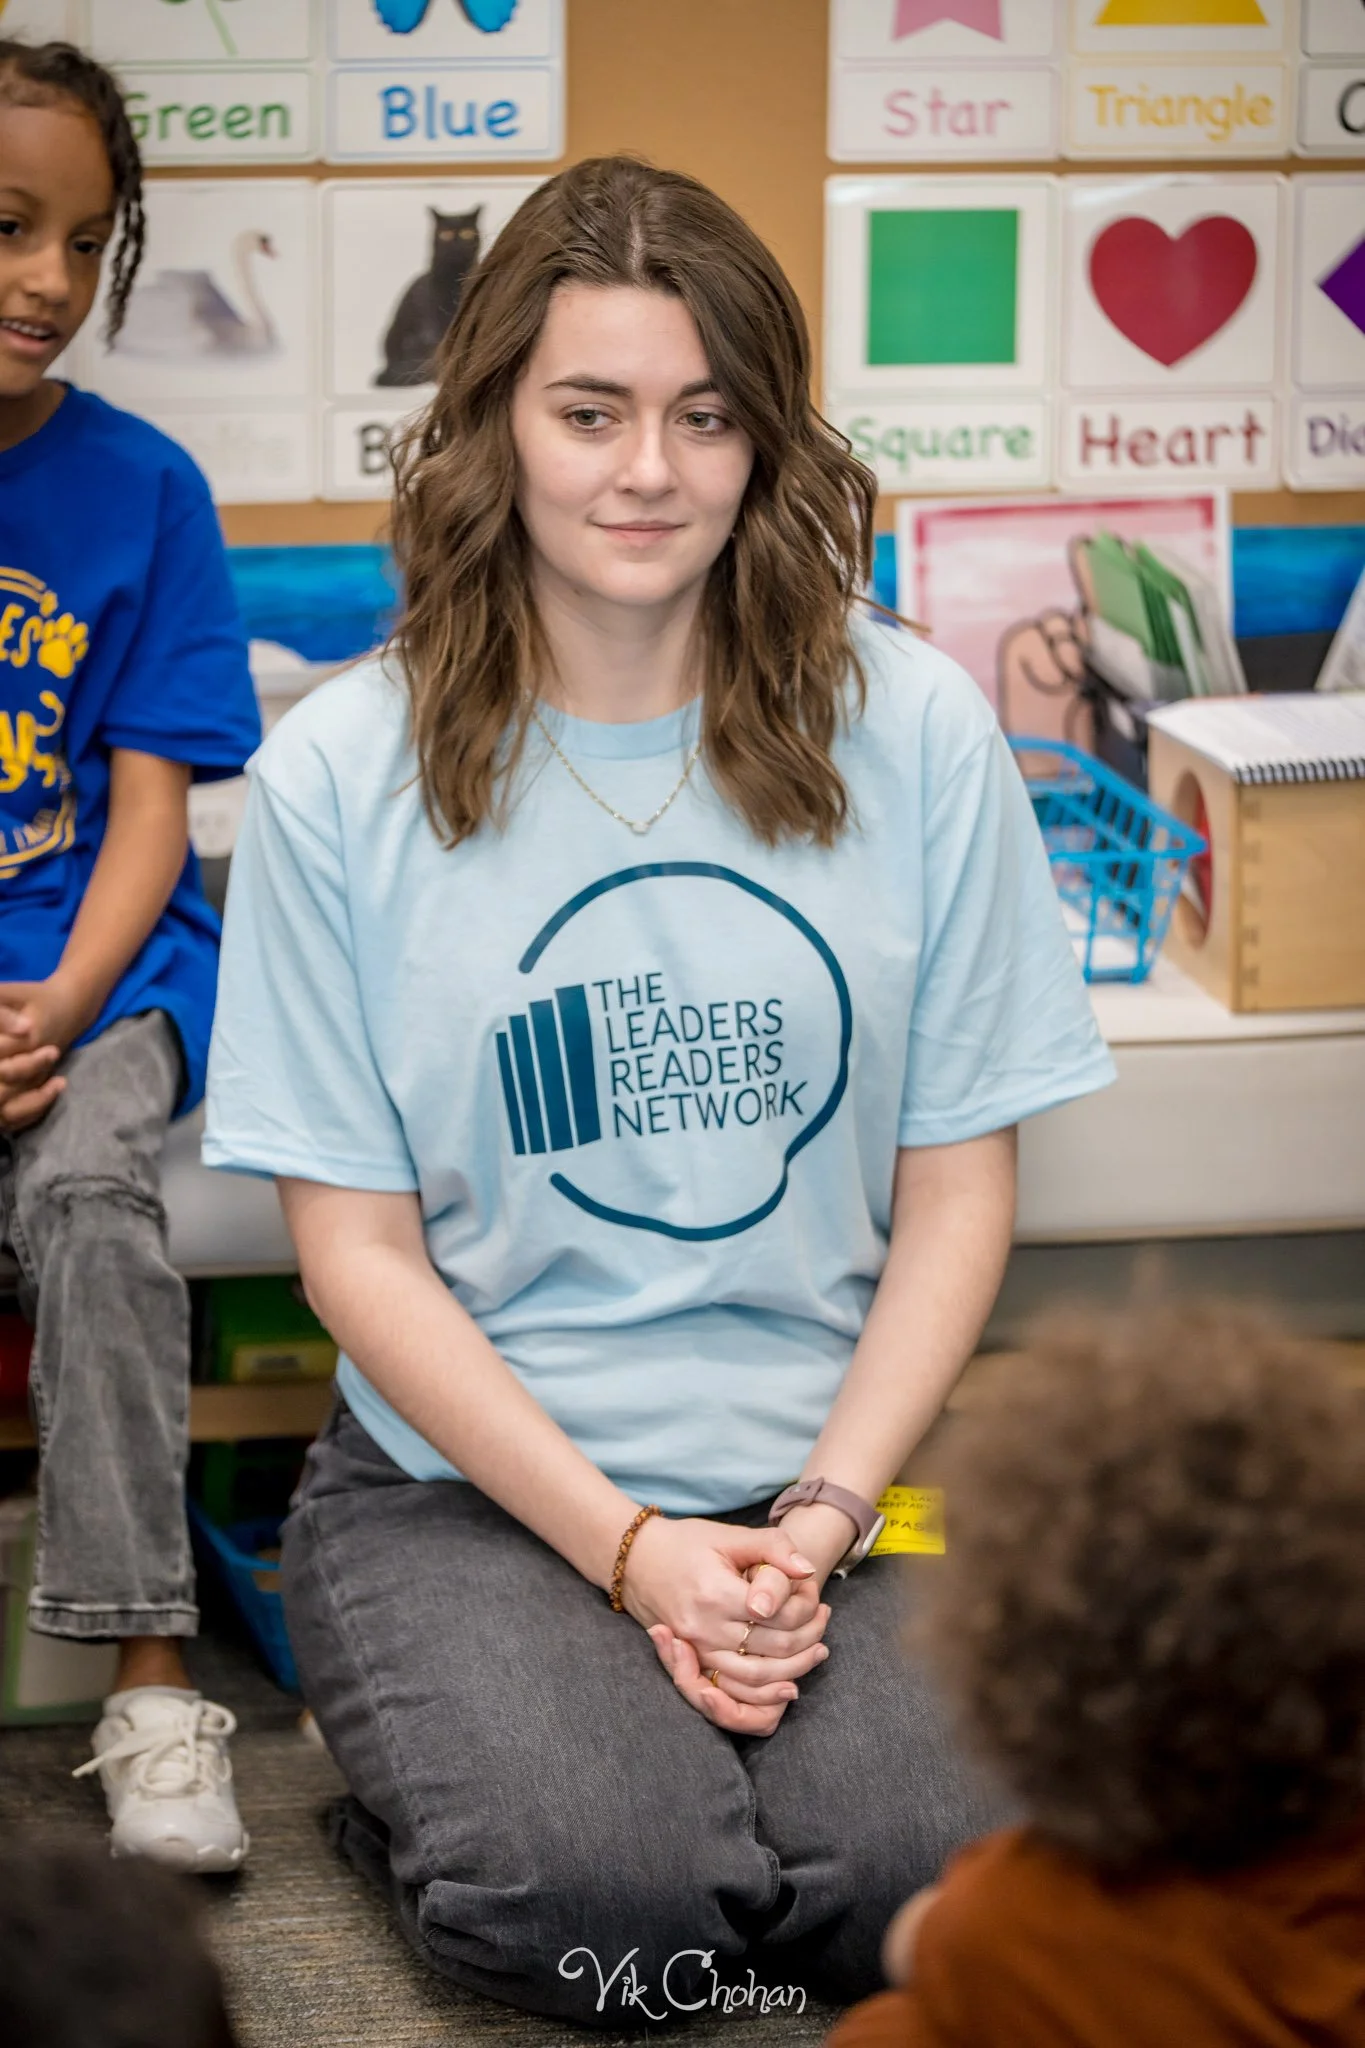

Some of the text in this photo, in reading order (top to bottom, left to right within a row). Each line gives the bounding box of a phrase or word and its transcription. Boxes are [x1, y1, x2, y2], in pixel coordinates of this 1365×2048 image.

[379, 85, 522, 139] Blue
[882, 86, 1012, 138] Star
[1086, 82, 1275, 141] Triangle
[847, 415, 1033, 475] Square
[1079, 408, 1266, 467] Heart
[592, 971, 666, 1012] THE
[606, 998, 783, 1054] LEADERS
[610, 1040, 784, 1097] READERS
[613, 1079, 808, 1139] NETWORK
[889, 1519, 931, 1532] PAS
